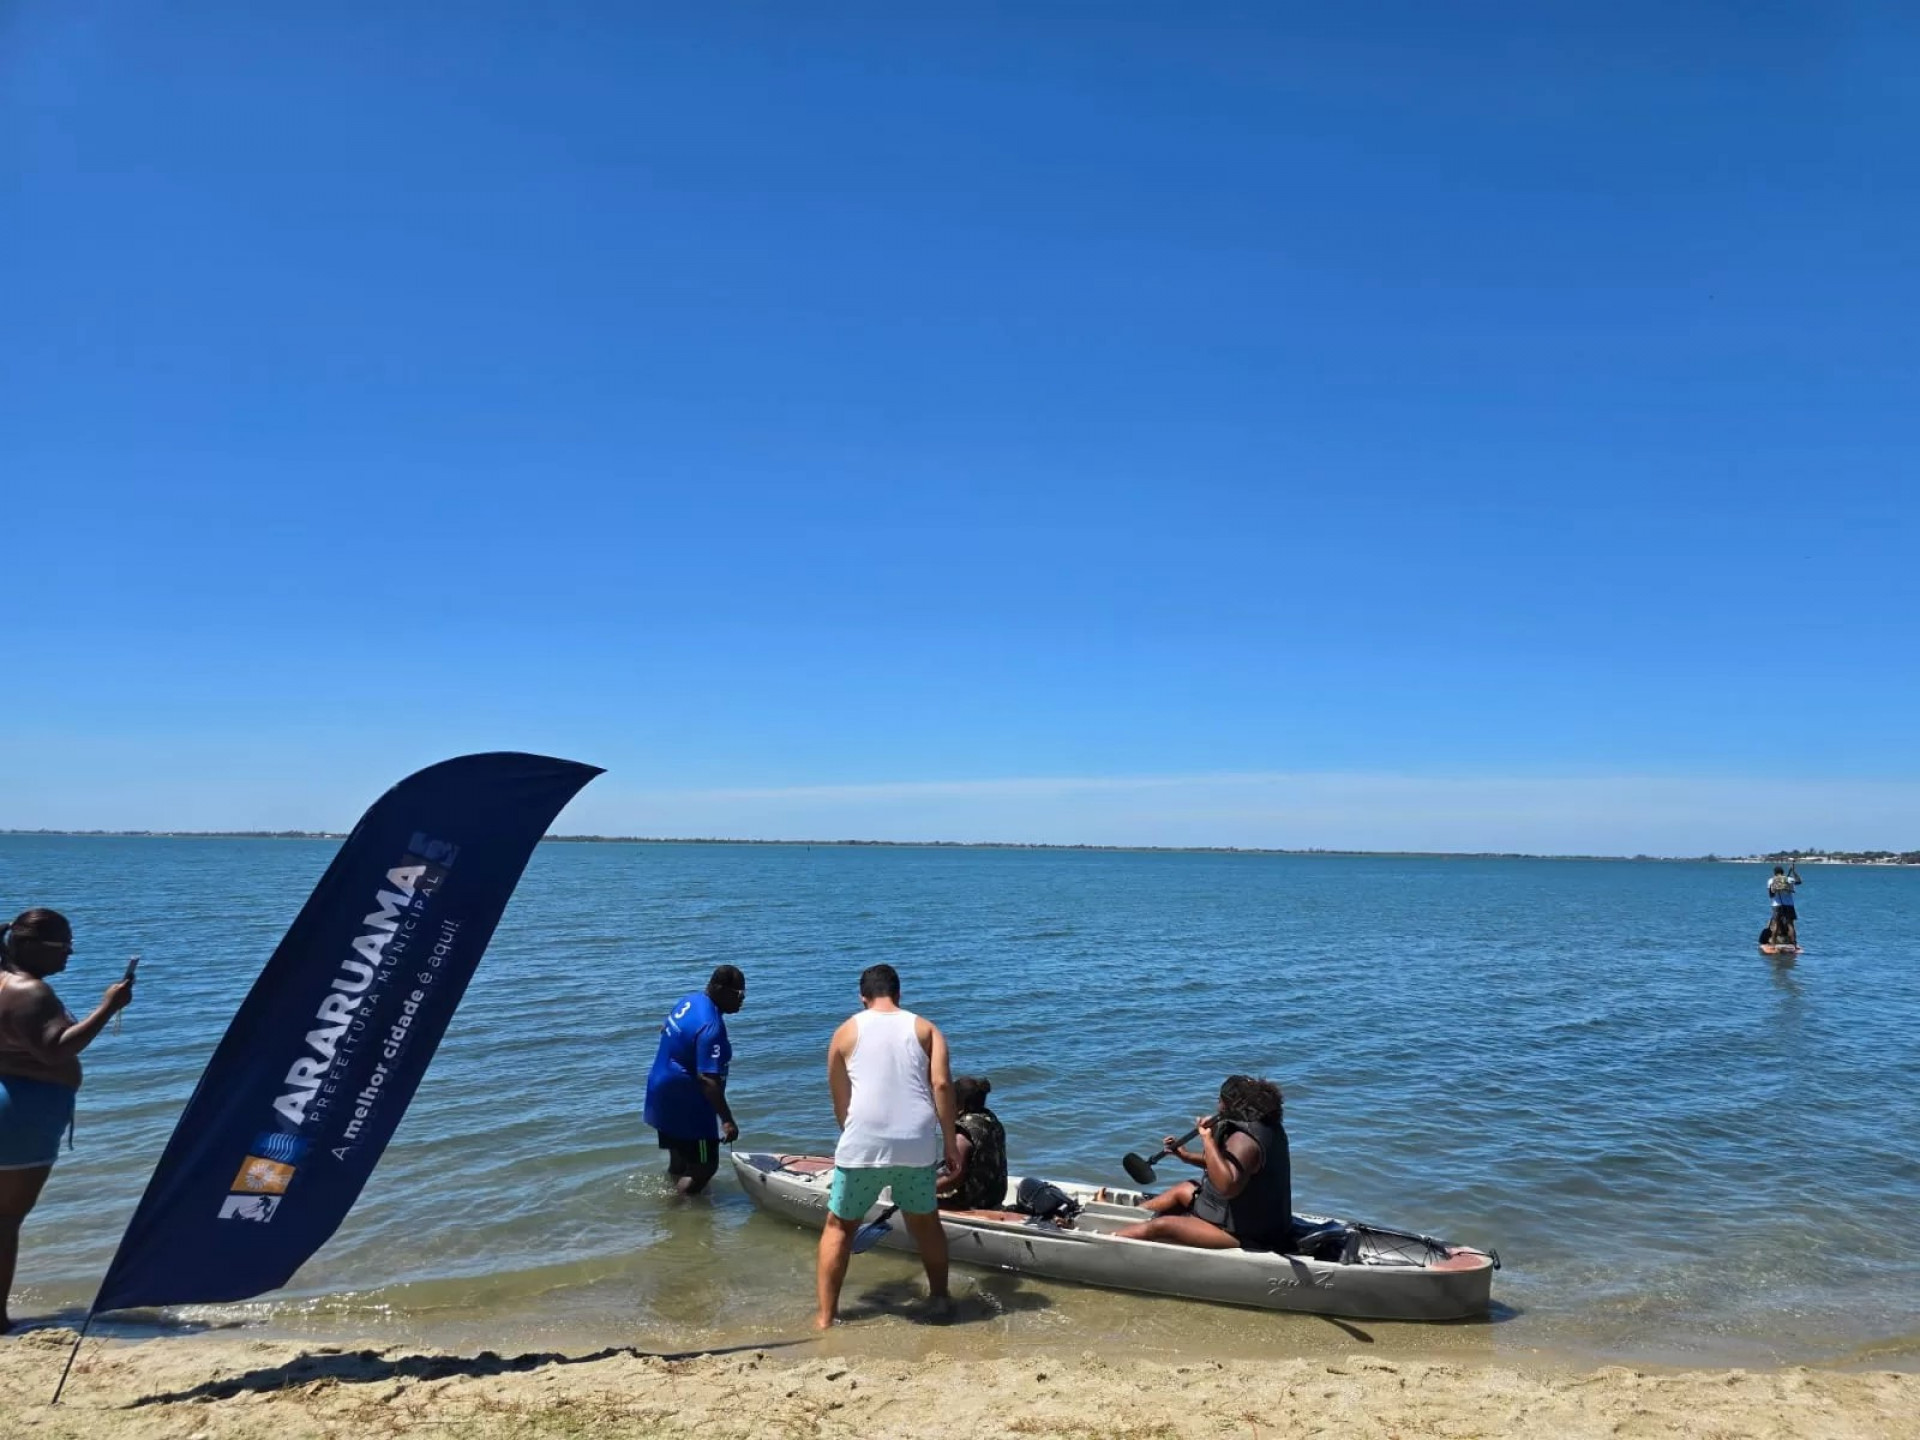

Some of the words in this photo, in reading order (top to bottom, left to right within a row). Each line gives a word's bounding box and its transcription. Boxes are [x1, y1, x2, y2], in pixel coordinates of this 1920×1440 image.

[272, 865, 426, 1125] ARARUAMA
[310, 993, 379, 1121] PREFEITURA
[378, 875, 439, 982] MUNICIPAL
[332, 1146, 349, 1161] A
[343, 1062, 388, 1140] melhor
[383, 988, 424, 1059] cidade
[418, 971, 433, 985] é
[427, 919, 460, 968] aqui!
[711, 1044, 721, 1058] 3
